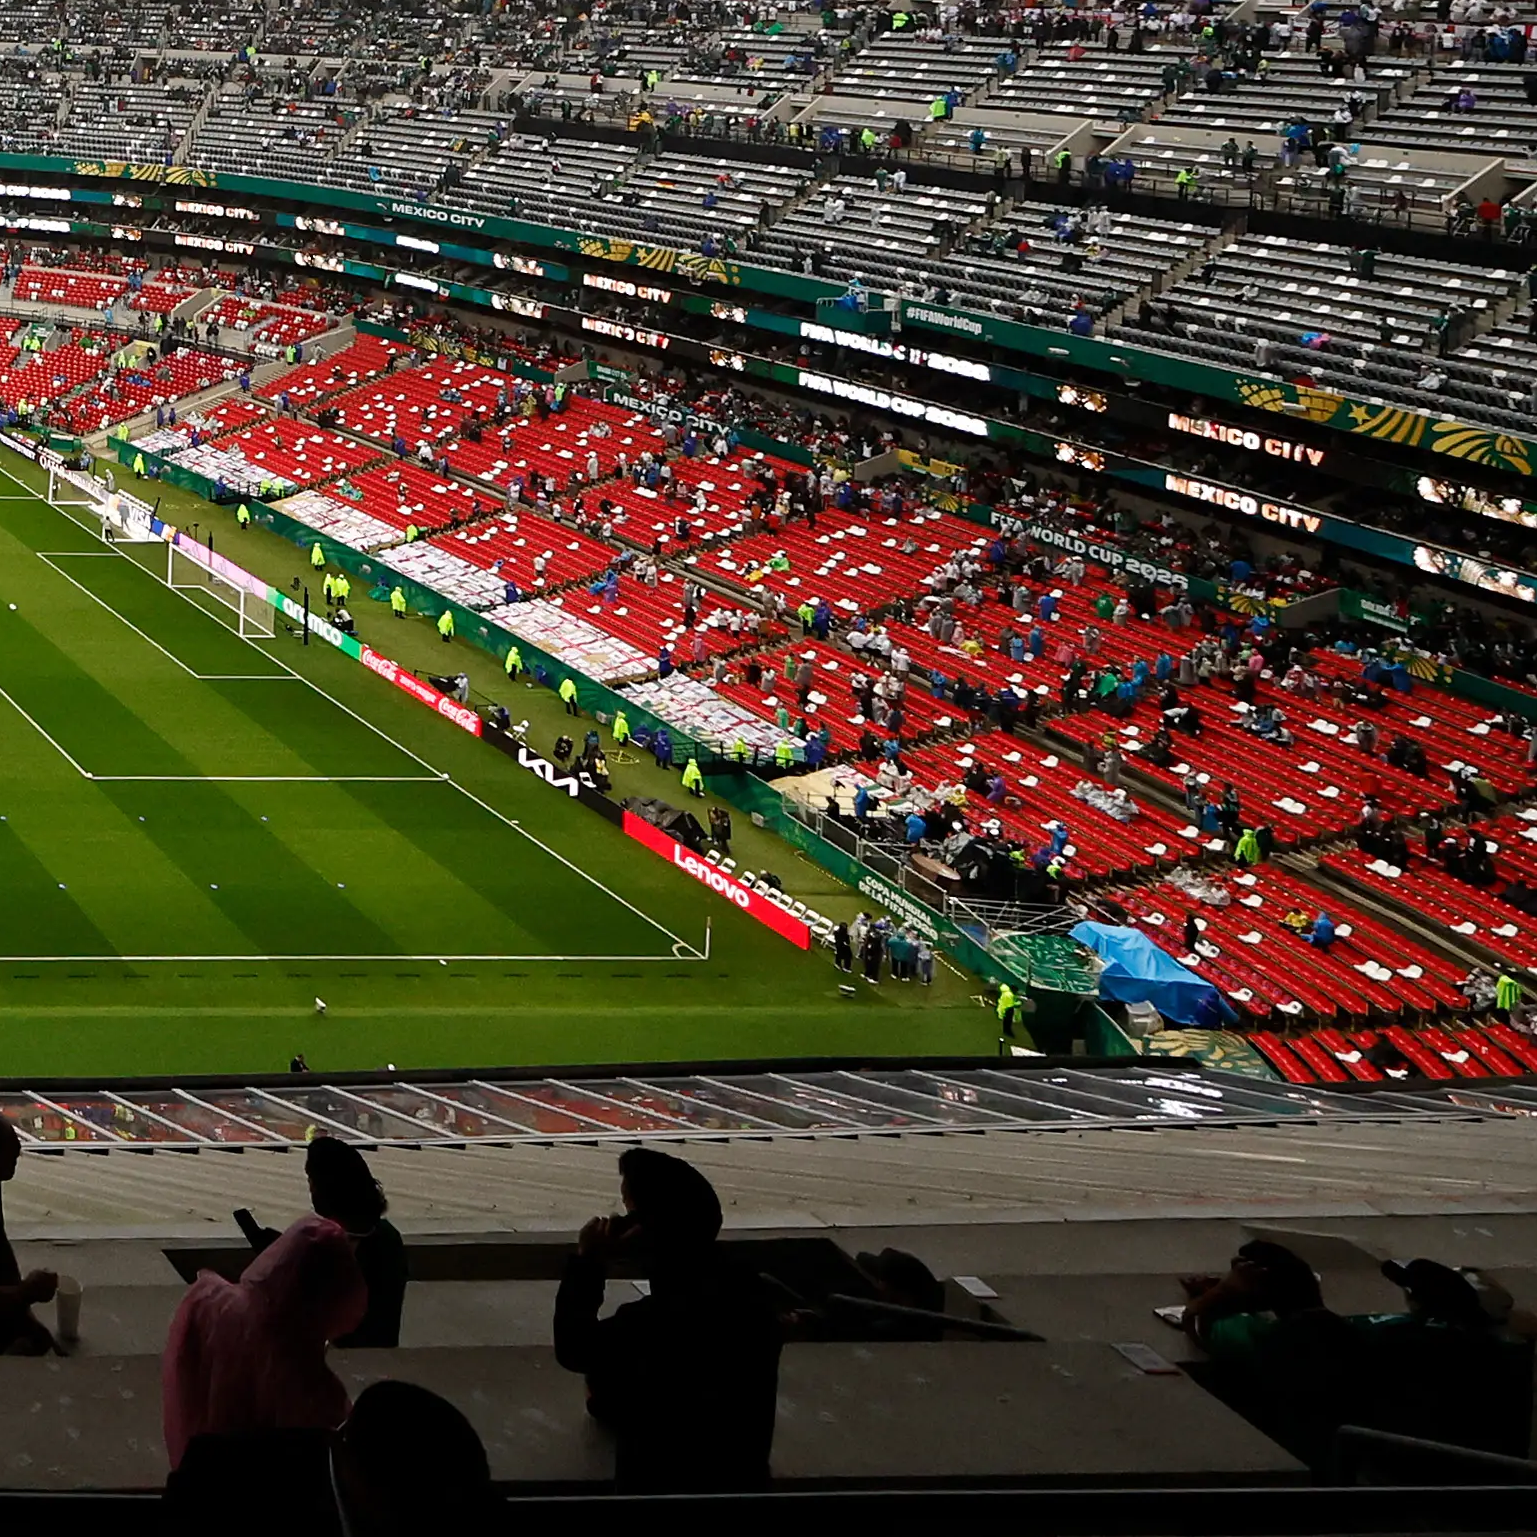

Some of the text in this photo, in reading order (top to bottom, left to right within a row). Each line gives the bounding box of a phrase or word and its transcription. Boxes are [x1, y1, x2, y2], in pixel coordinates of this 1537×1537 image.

[392, 202, 485, 228] MEXICO CITY
[224, 242, 254, 255] CITY
[637, 286, 671, 303] CITY
[906, 306, 982, 335] #FIFAWorldCup
[799, 322, 990, 381] FIFA 2026
[613, 392, 683, 422] MEXICO
[798, 371, 834, 393] FIFA
[832, 379, 891, 409] WORLD
[890, 395, 926, 418] CUP
[1165, 474, 1322, 533] MEXICO CITY
[1029, 525, 1086, 554] WORLD
[1088, 545, 1123, 565] CUP
[1126, 558, 1189, 591] 2026
[282, 597, 343, 647] aramco
[518, 747, 579, 797] KIA
[674, 843, 750, 908] Lenovo
[858, 880, 871, 894] DE
[870, 889, 884, 904] LA
[884, 897, 906, 919] FIFA
[864, 875, 933, 927] COPA MUNDIAL
